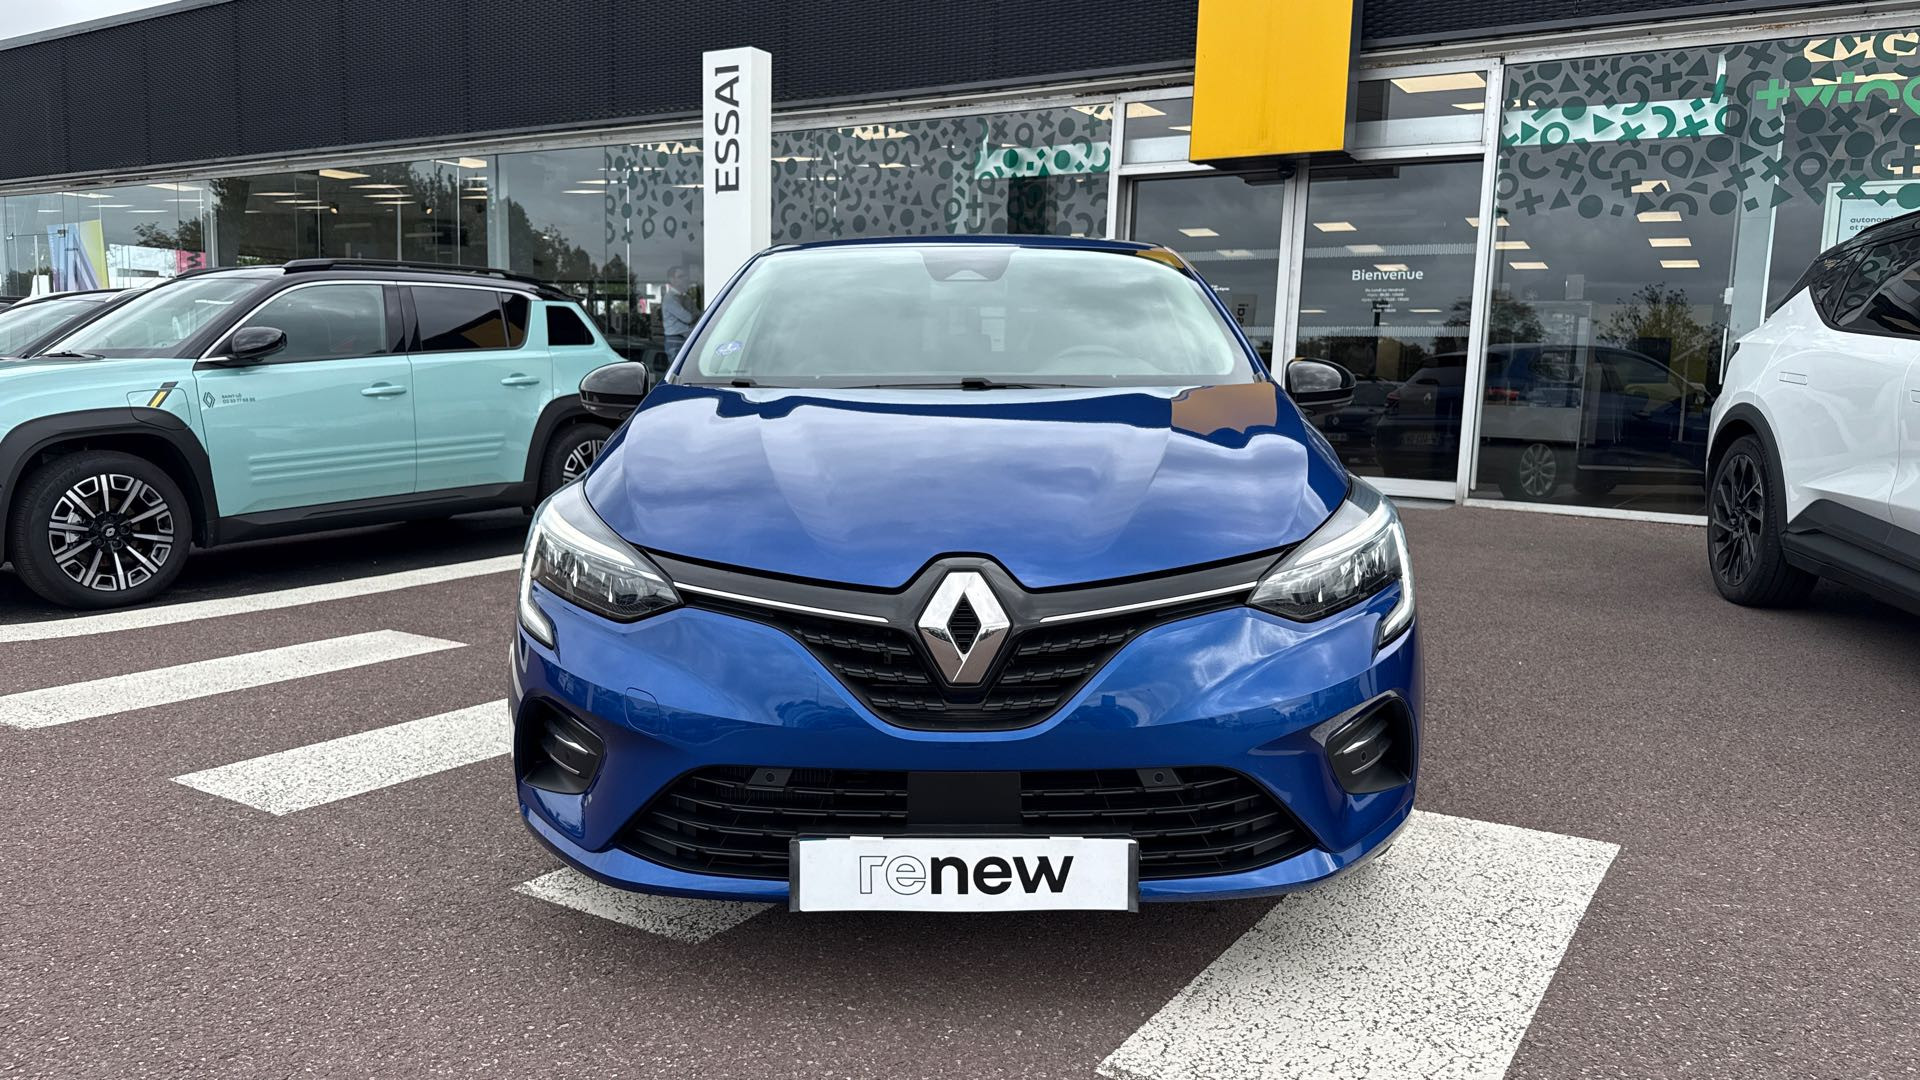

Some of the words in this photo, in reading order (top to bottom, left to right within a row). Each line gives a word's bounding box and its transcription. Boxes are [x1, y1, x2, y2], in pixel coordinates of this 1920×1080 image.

[715, 65, 739, 194] ESSAI
[1351, 269, 1424, 281] Bienvenue
[859, 855, 1075, 895] renew
